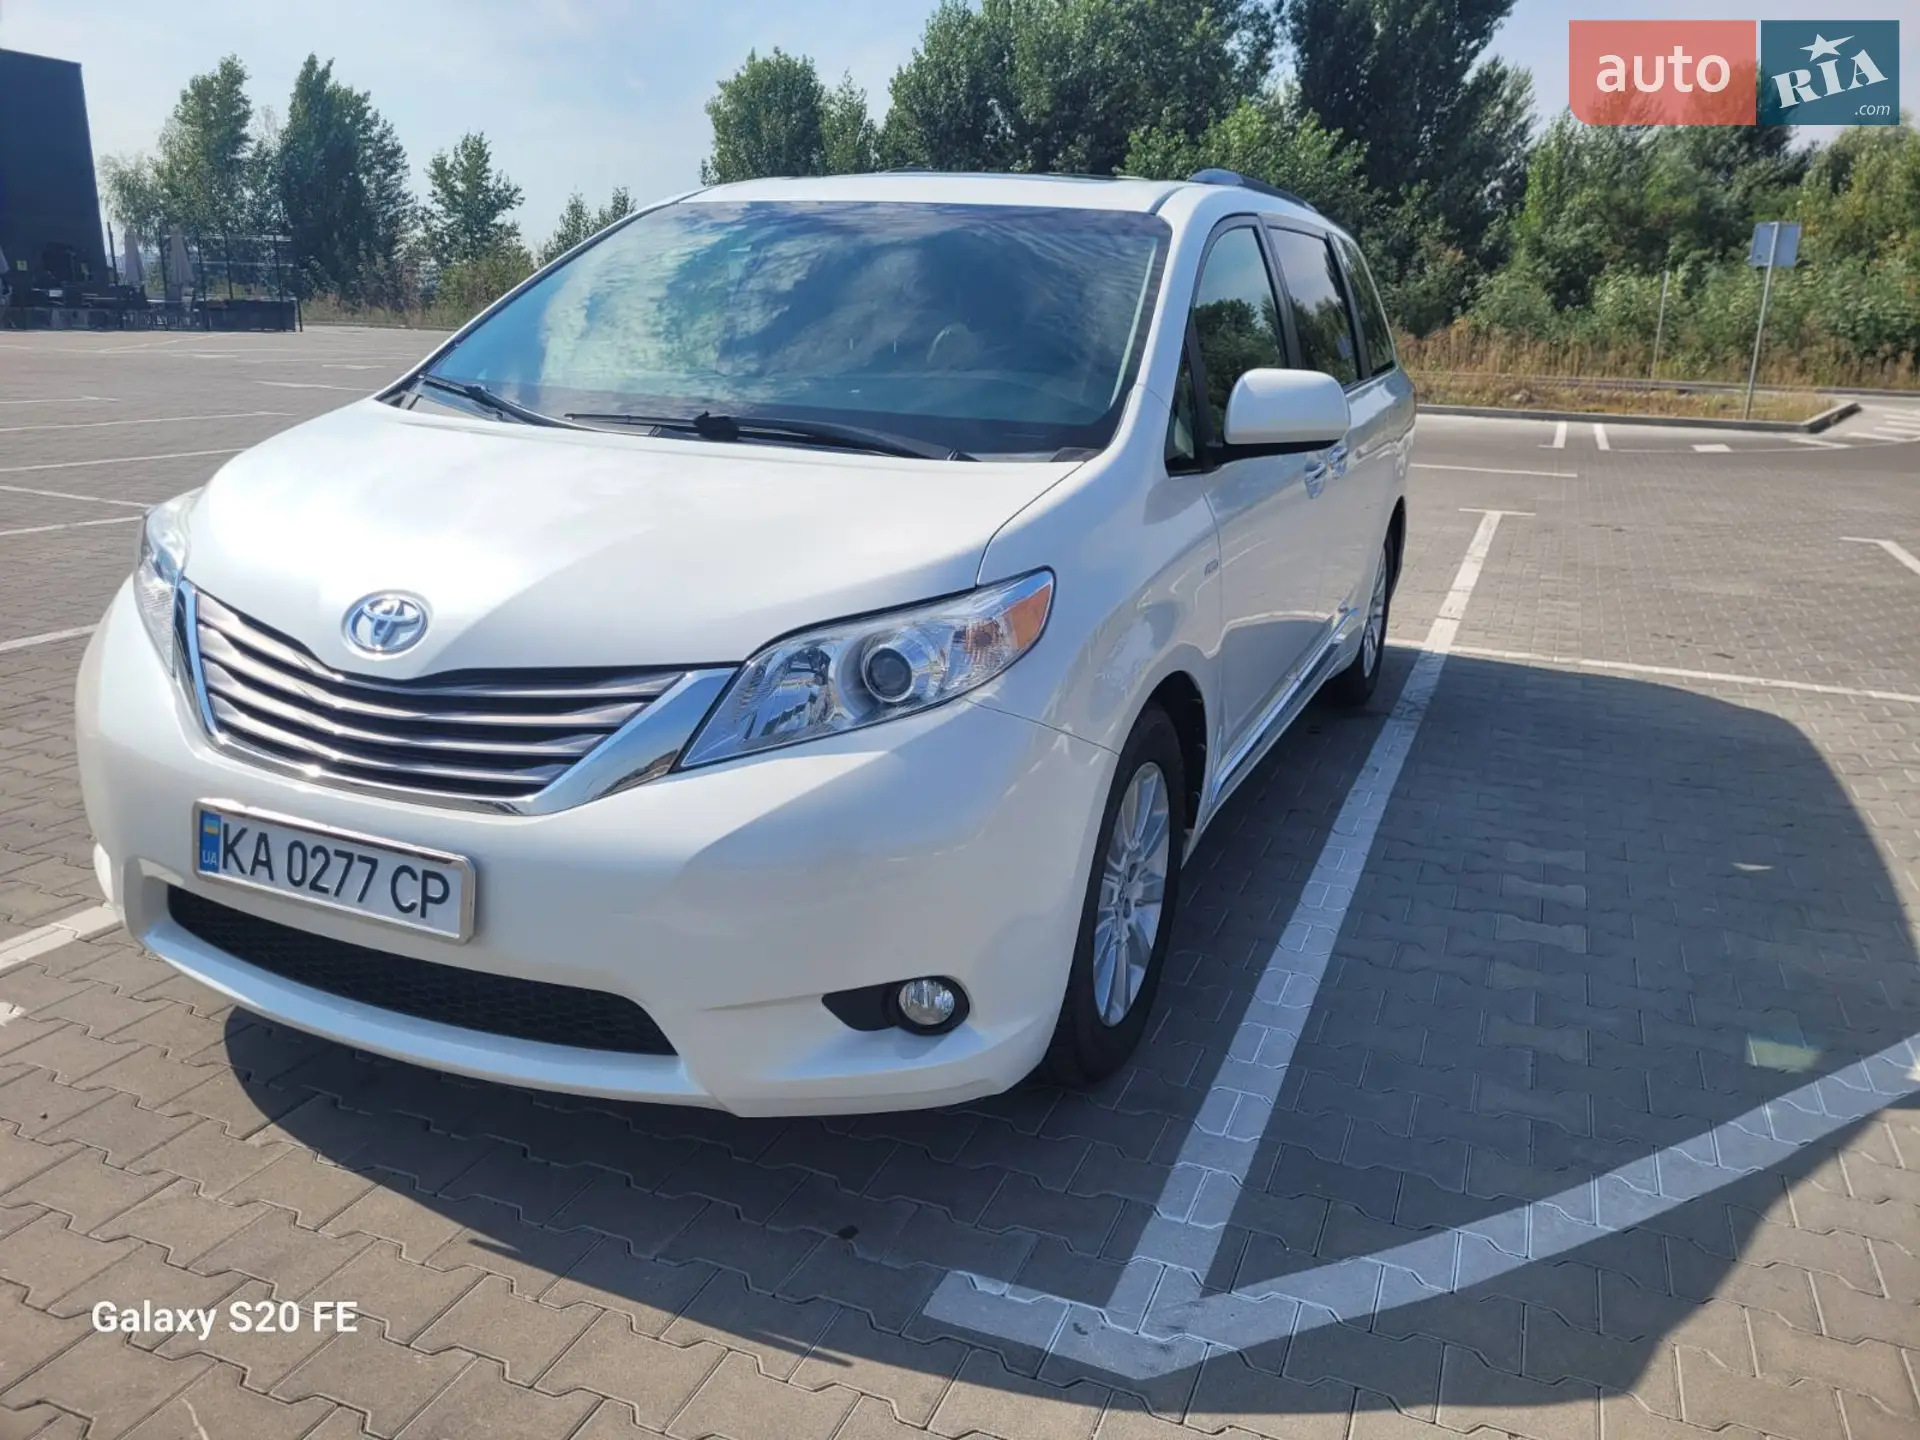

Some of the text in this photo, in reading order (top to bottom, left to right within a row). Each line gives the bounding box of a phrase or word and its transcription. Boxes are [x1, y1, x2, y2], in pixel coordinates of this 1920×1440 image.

[202, 850, 218, 867] UA
[222, 822, 450, 919] KA 0277 CP
